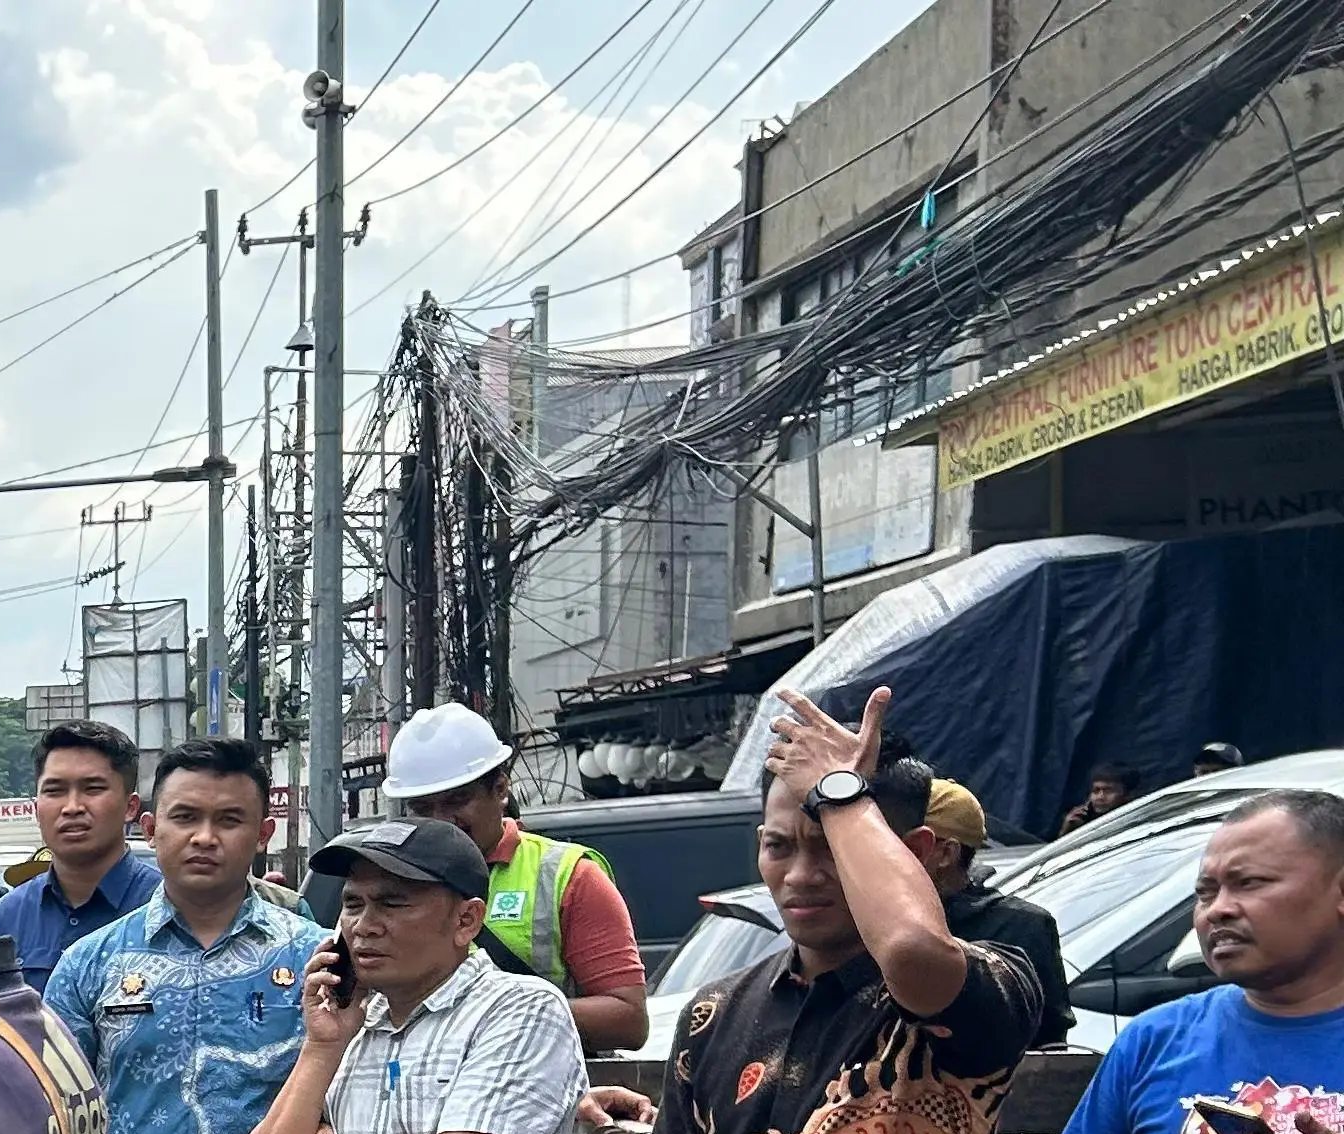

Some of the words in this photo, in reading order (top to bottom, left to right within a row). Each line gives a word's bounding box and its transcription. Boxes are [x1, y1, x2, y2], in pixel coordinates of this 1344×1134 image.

[983, 383, 1054, 440] CENTRAL
[1058, 331, 1160, 403] FURNITURE
[1163, 302, 1220, 364] TOKO
[1227, 252, 1339, 336] CENTRAL
[1090, 384, 1145, 429] ECERAN
[1178, 351, 1233, 397] HARGA
[1199, 489, 1344, 526] PHANT
